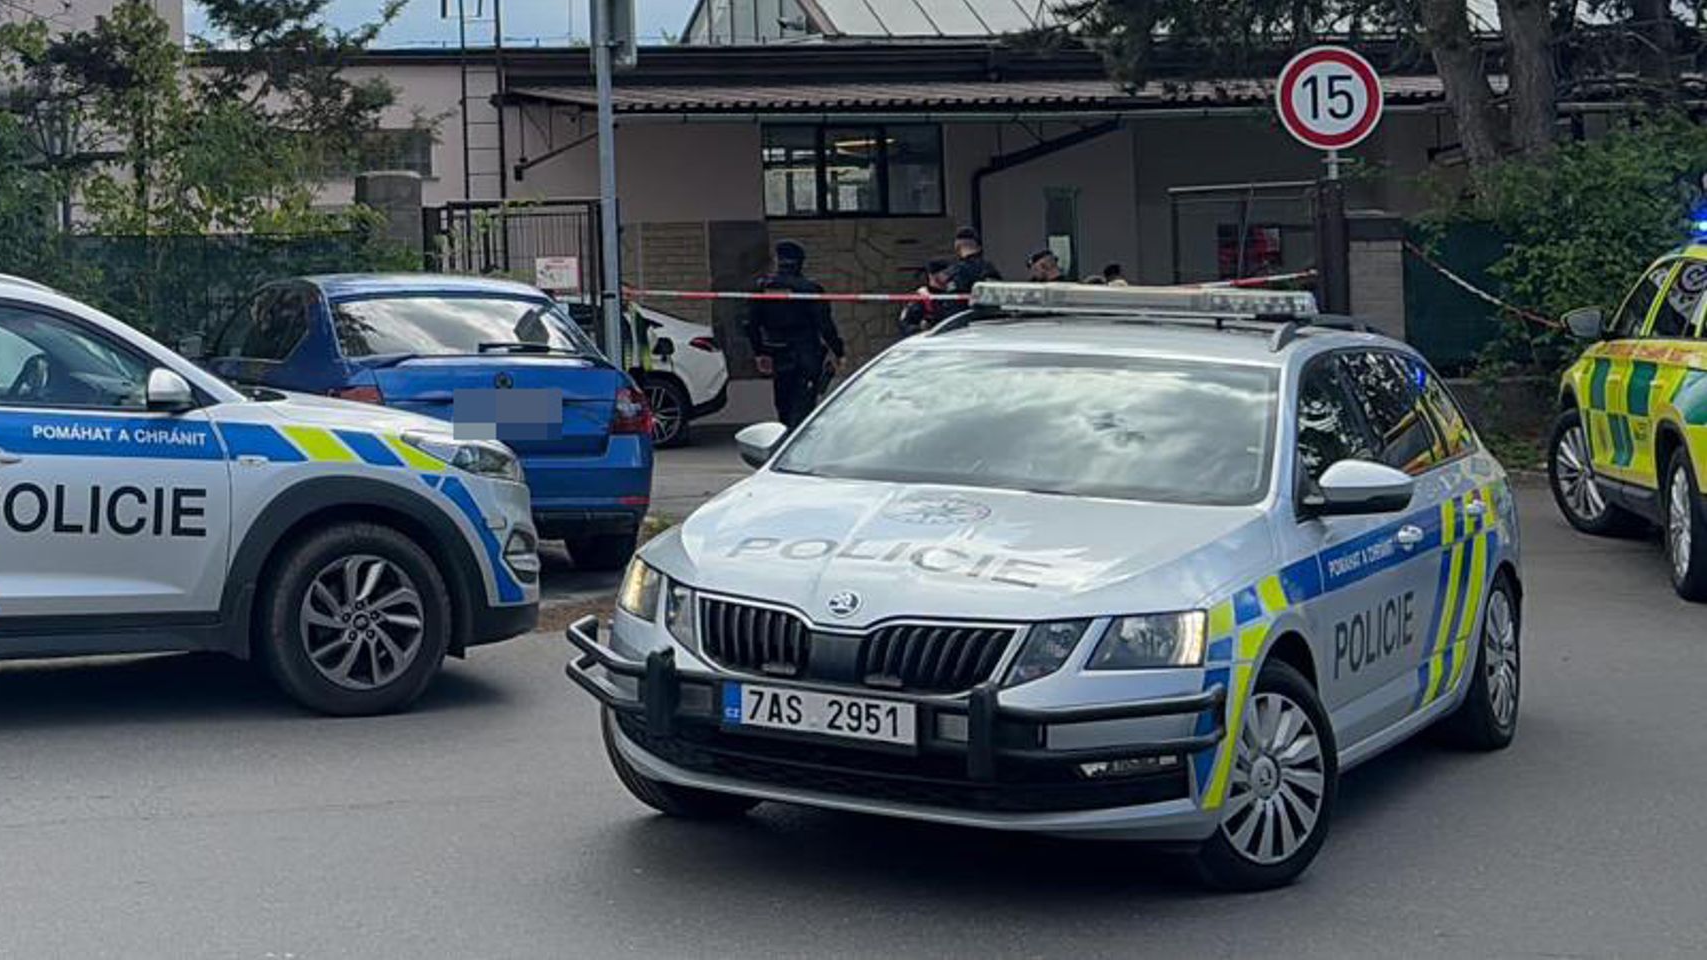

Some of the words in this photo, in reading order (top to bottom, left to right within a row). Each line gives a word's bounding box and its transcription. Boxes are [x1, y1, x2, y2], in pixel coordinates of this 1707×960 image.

[1302, 75, 1354, 120] 15
[32, 422, 112, 441] POMÁHAT
[118, 428, 130, 441] A
[134, 426, 207, 446] CHRÁNIT
[725, 537, 1053, 588] POLICIE
[1333, 591, 1415, 680] POLICIE
[749, 690, 802, 725] 7AS
[827, 700, 898, 737] 2951
